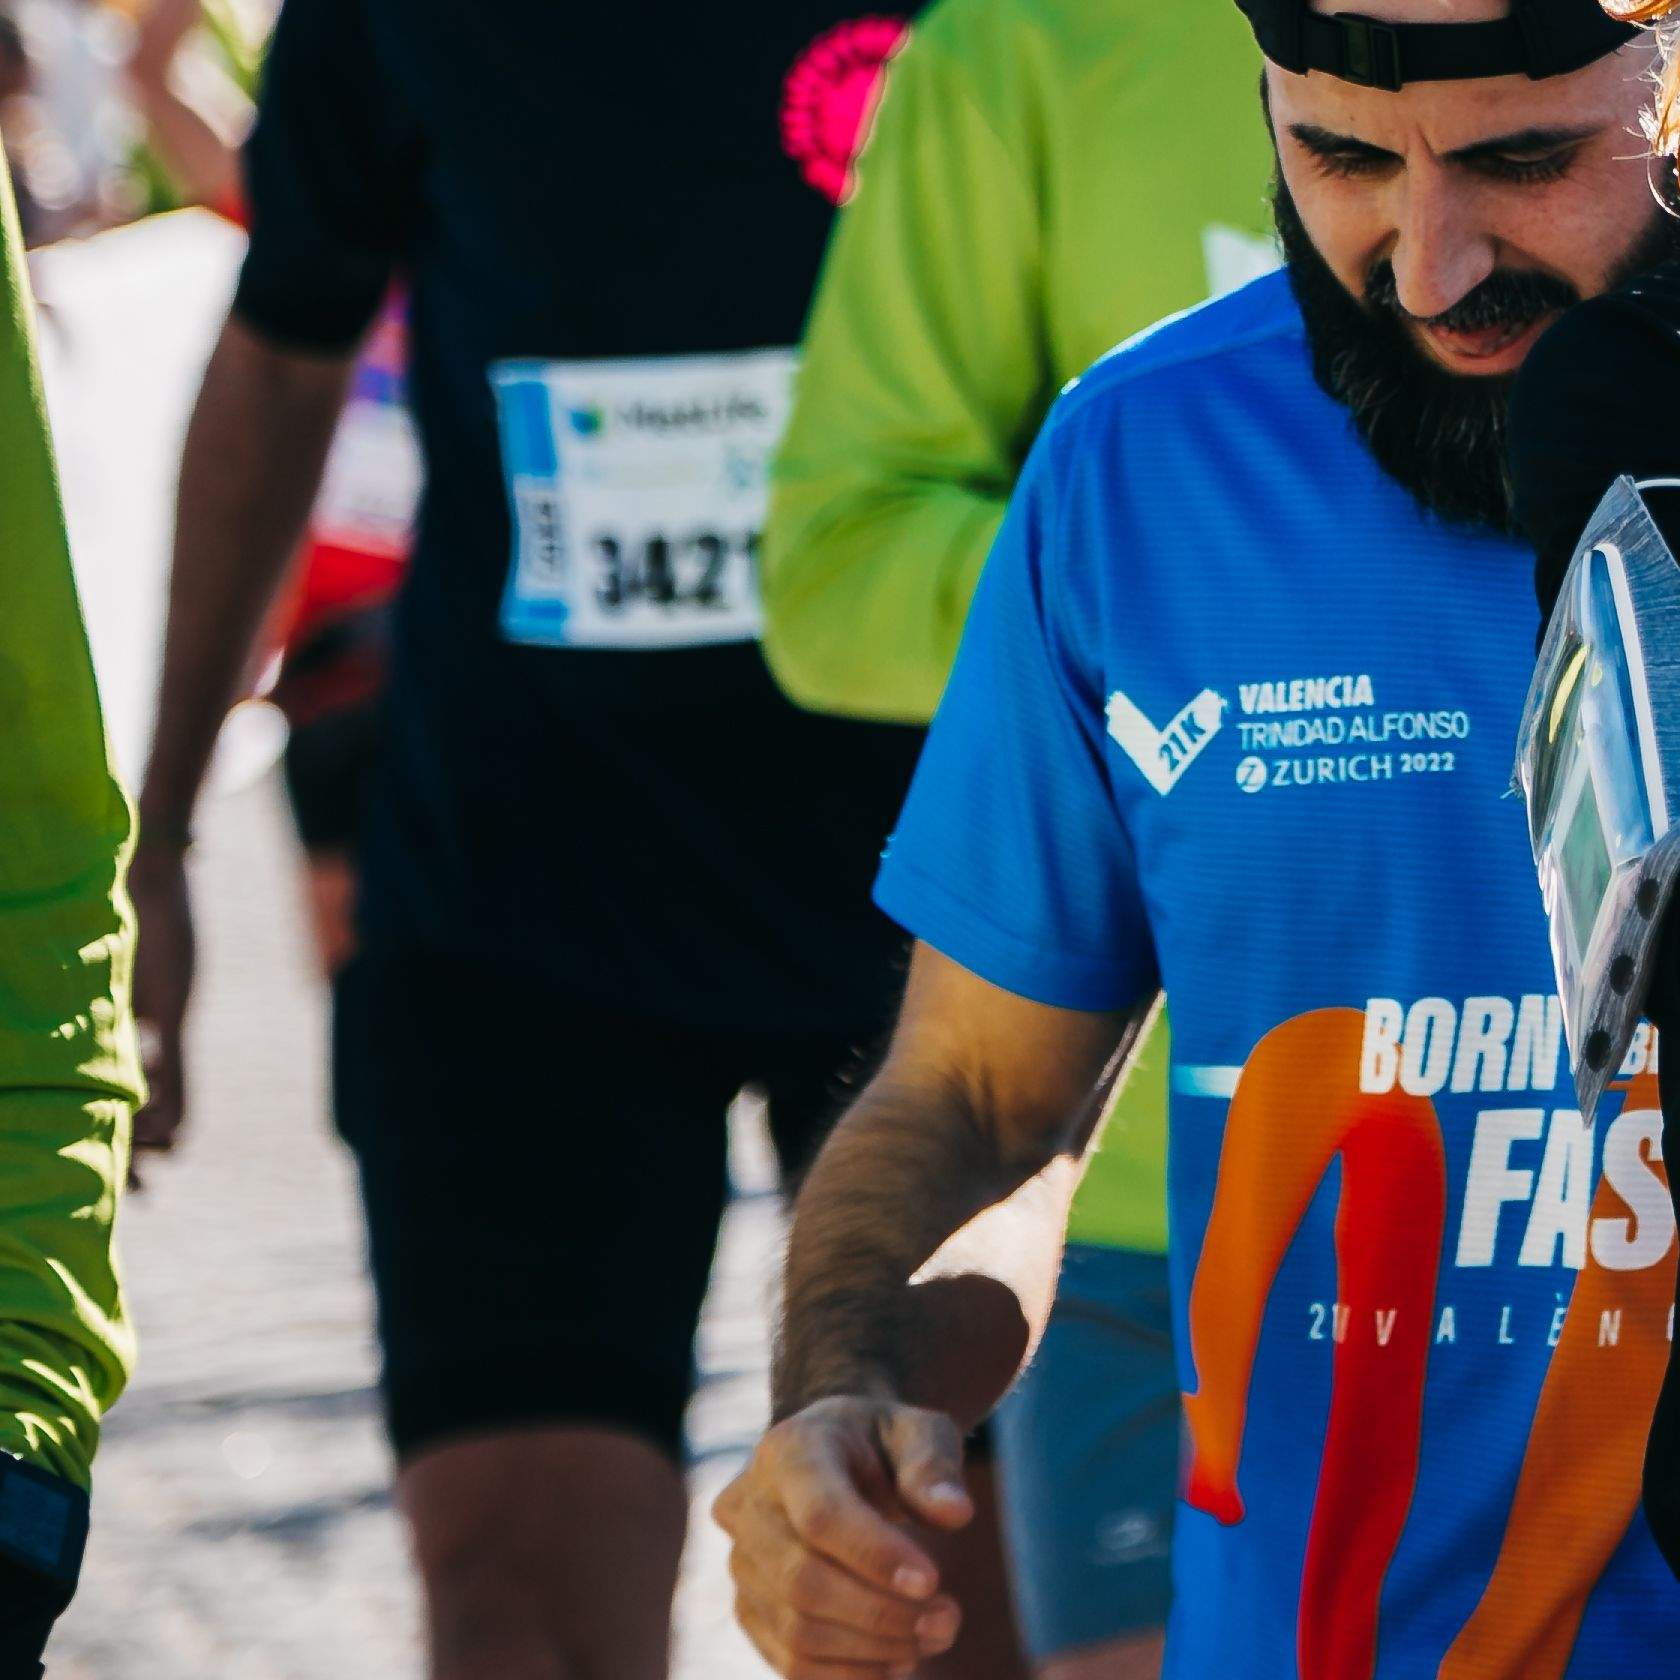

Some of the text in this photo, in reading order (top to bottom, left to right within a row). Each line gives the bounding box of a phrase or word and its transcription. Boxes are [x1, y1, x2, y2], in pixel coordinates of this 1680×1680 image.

[1239, 674, 1375, 714] VALENCIA
[1238, 711, 1470, 751] TRINIDAD ALFONSO
[1272, 754, 1393, 786] ZURICH
[1400, 752, 1455, 773] 2022
[1359, 994, 1564, 1096] BORN
